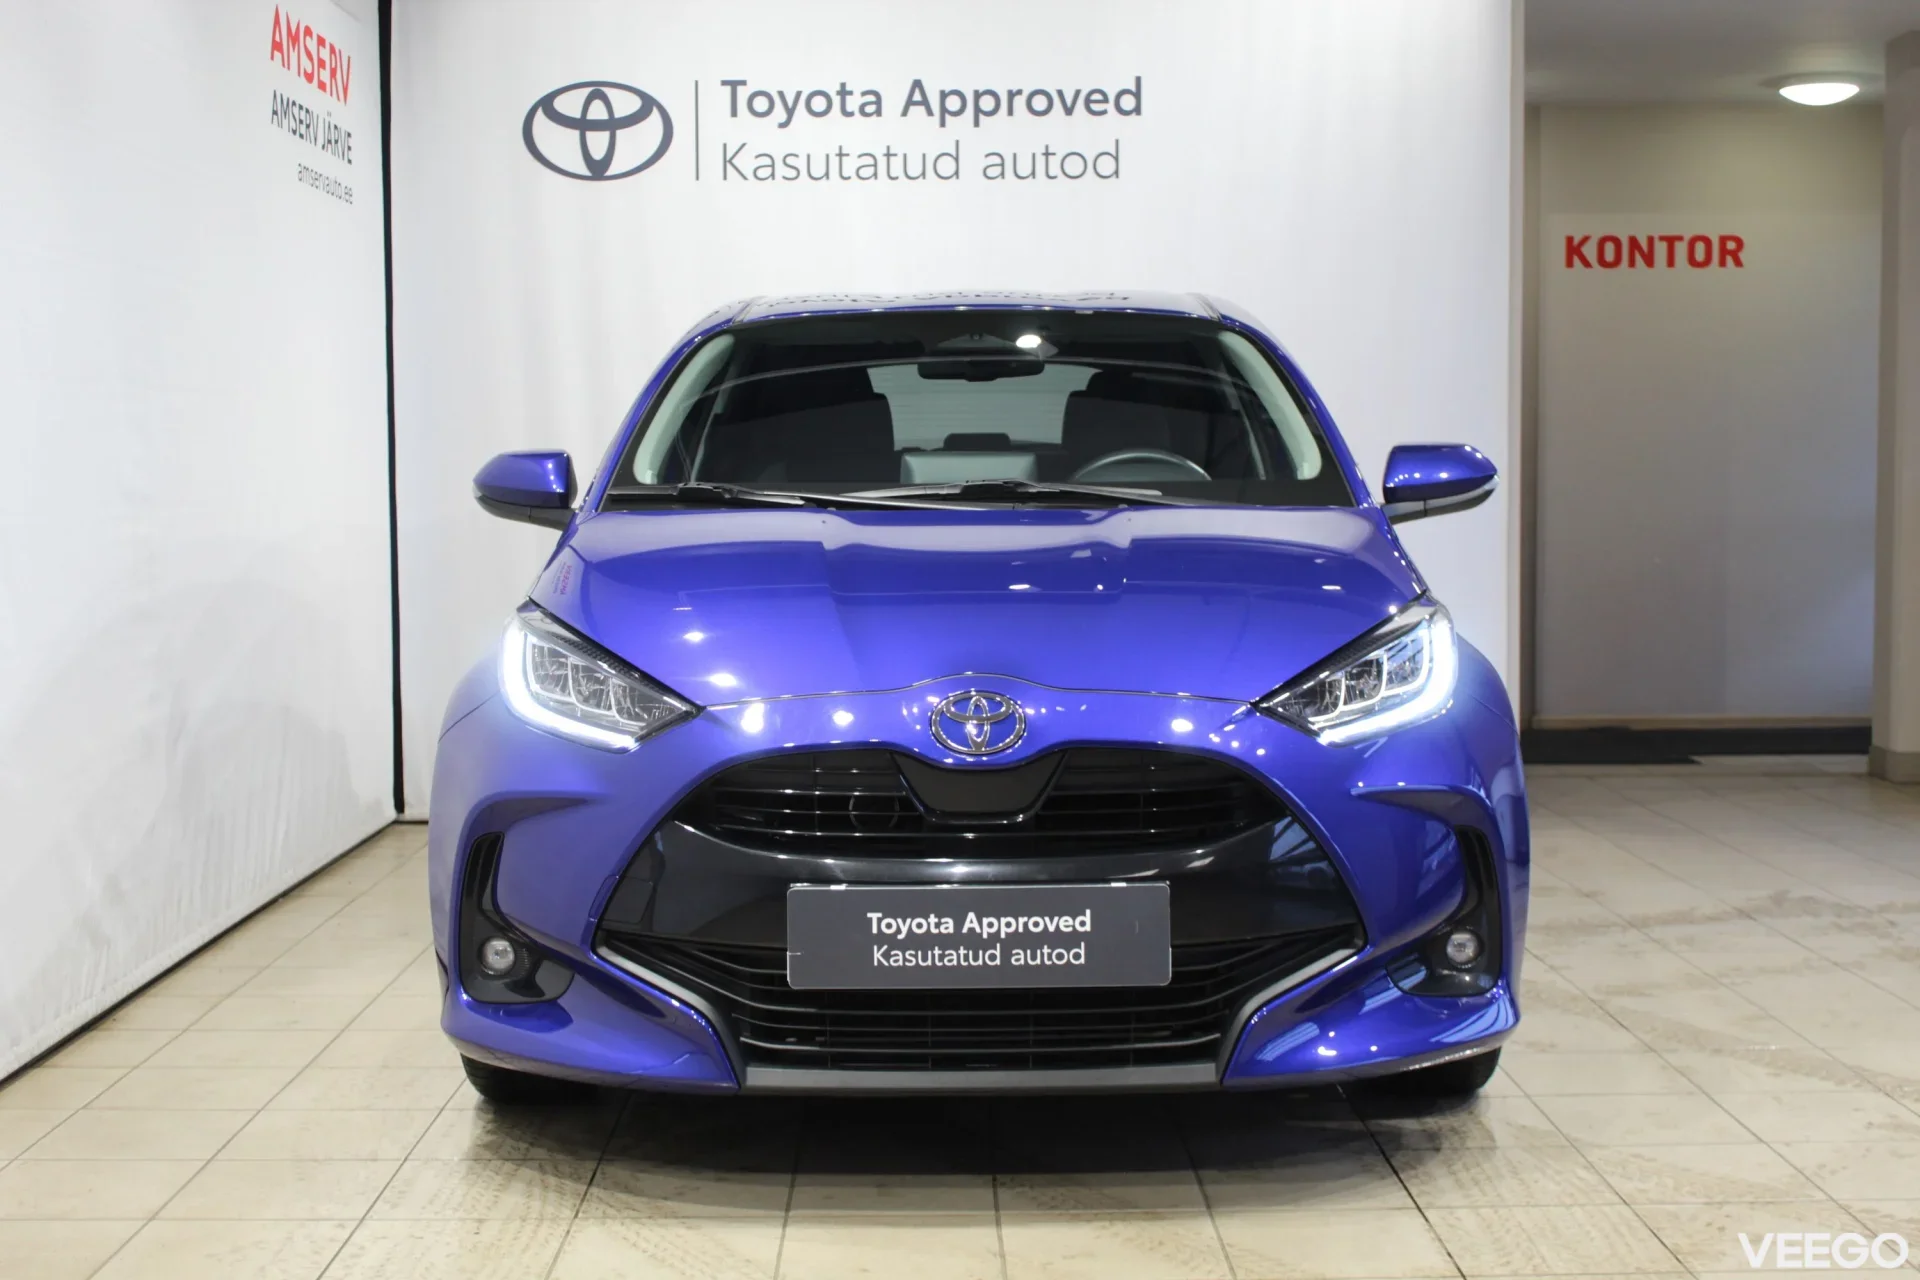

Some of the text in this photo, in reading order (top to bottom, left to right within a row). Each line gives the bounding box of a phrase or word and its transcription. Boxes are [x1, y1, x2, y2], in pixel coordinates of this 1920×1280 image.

[270, 3, 351, 106] AMSERV
[721, 76, 1142, 129] Toyota Approved
[271, 89, 353, 165] AMSERV JÄRVE
[724, 139, 1120, 181] Kasutatud autod
[297, 162, 353, 205] amservauto.ee
[1565, 234, 1745, 269] KONTOR
[867, 908, 1092, 939] Toyota Approved
[873, 942, 1086, 967] Kasutatud autod
